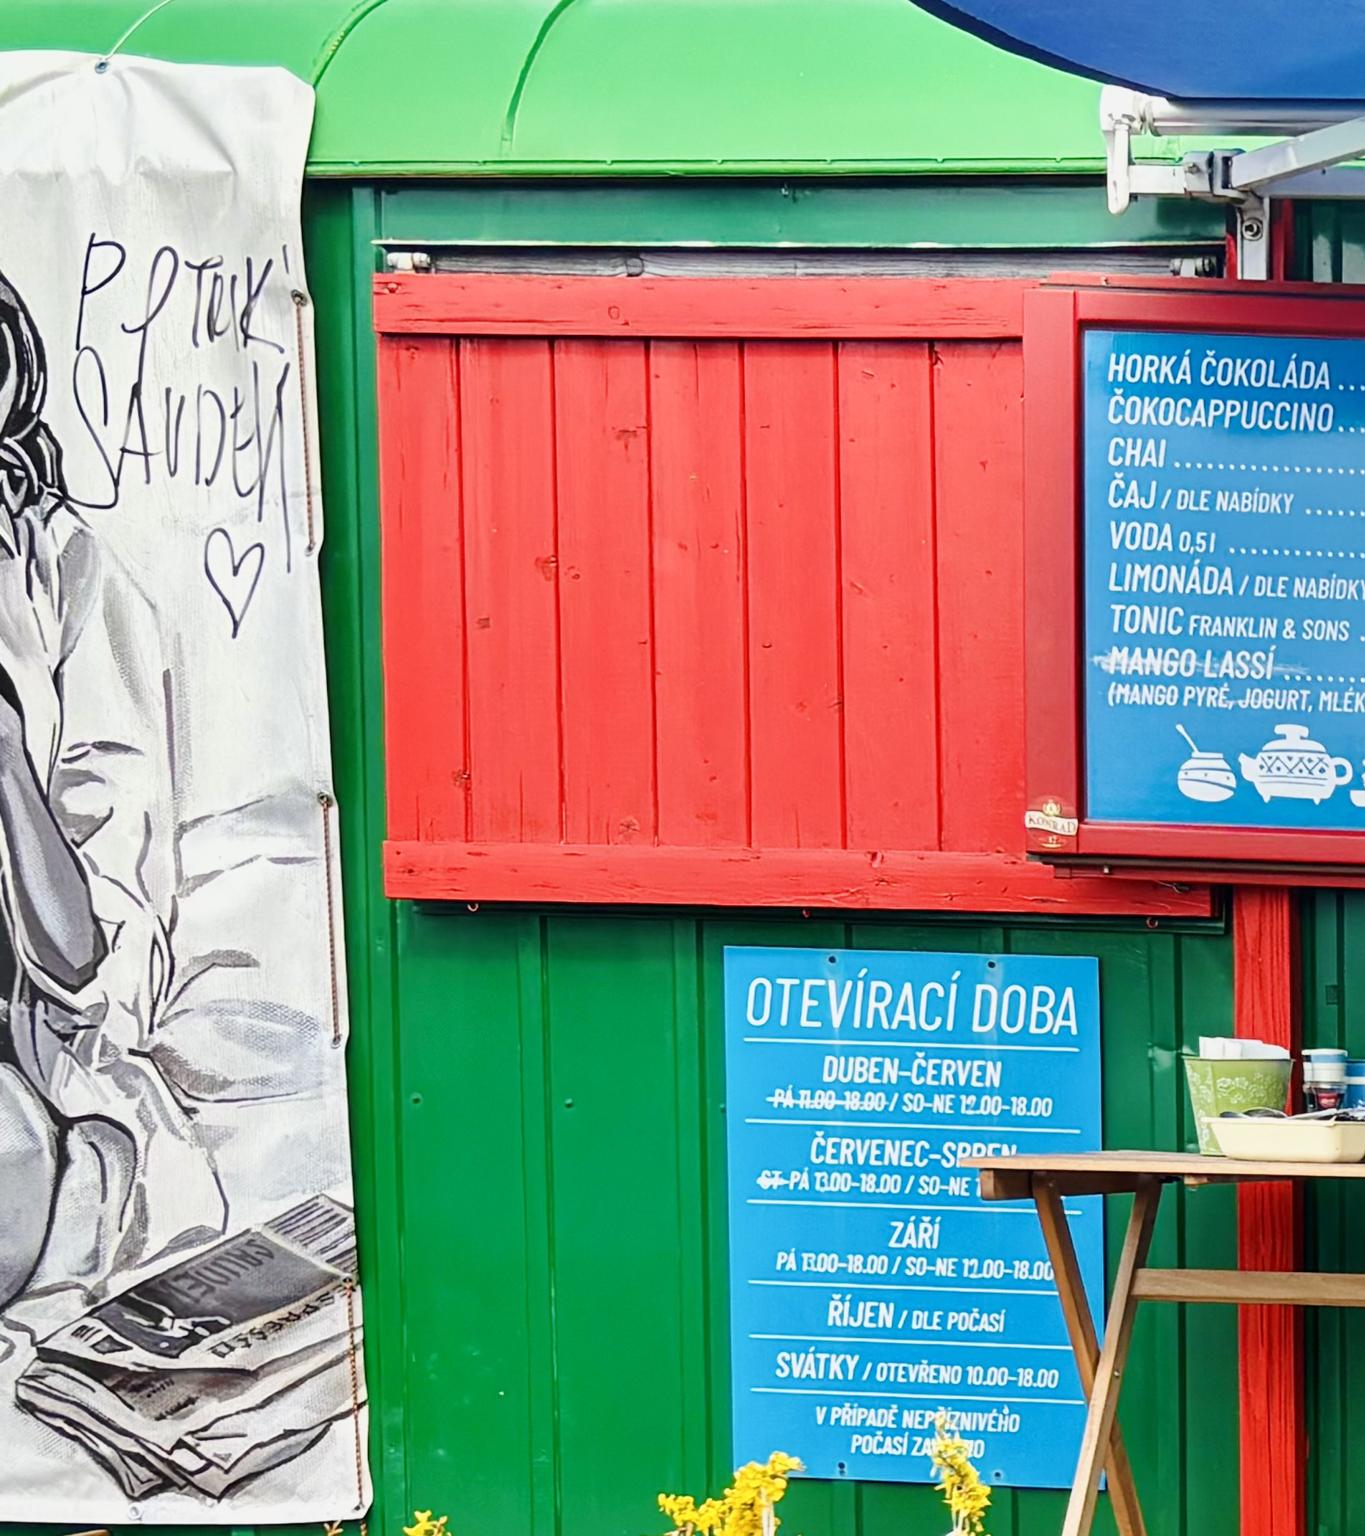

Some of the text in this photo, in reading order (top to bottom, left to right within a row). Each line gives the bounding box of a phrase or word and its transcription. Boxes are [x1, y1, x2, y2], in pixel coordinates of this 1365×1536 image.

[1107, 350, 1191, 386] HORKÁ
[1200, 351, 1331, 390] ČOKOLÁDA
[1107, 388, 1334, 432] ČOKOCAPPUCCINO
[1107, 437, 1166, 468] CHAI
[1107, 472, 1157, 509] ČAJ
[1177, 489, 1210, 512] DLE
[1216, 488, 1294, 515] NABÍDKY
[1110, 521, 1173, 552] VODA
[1108, 558, 1234, 596] LIMONÁDA
[1254, 575, 1288, 598] DLE
[1110, 604, 1184, 635] TONIC
[1189, 615, 1277, 639] FRANKLIN
[1282, 617, 1296, 639] &
[1302, 618, 1350, 642] SONS
[1108, 647, 1197, 677] MANGO
[1203, 645, 1277, 680] LASSÍ
[1107, 682, 1179, 708] (MANGO
[1239, 687, 1314, 714] JOGURT,
[746, 967, 1078, 1036] OTEVÍRACÍ DOBA
[822, 1051, 1002, 1088] DUBEN-ČERVEN
[902, 1092, 955, 1114] SO-NE
[917, 1175, 971, 1197] SO-NE
[888, 1216, 941, 1250] ZÁŘÍ
[775, 1248, 796, 1271] PÁ
[904, 1256, 957, 1278] SO-NE
[827, 1293, 895, 1329] ŘÍJEN
[911, 1310, 943, 1331] DLE
[947, 1307, 1006, 1333] POČASÍ
[775, 1346, 859, 1381] SVÁTKY
[876, 1359, 962, 1385] OTEVŘENO
[816, 1406, 828, 1425] V
[830, 1402, 900, 1429] PŘÍPADĚ
[851, 1431, 909, 1456] POČASÍ
